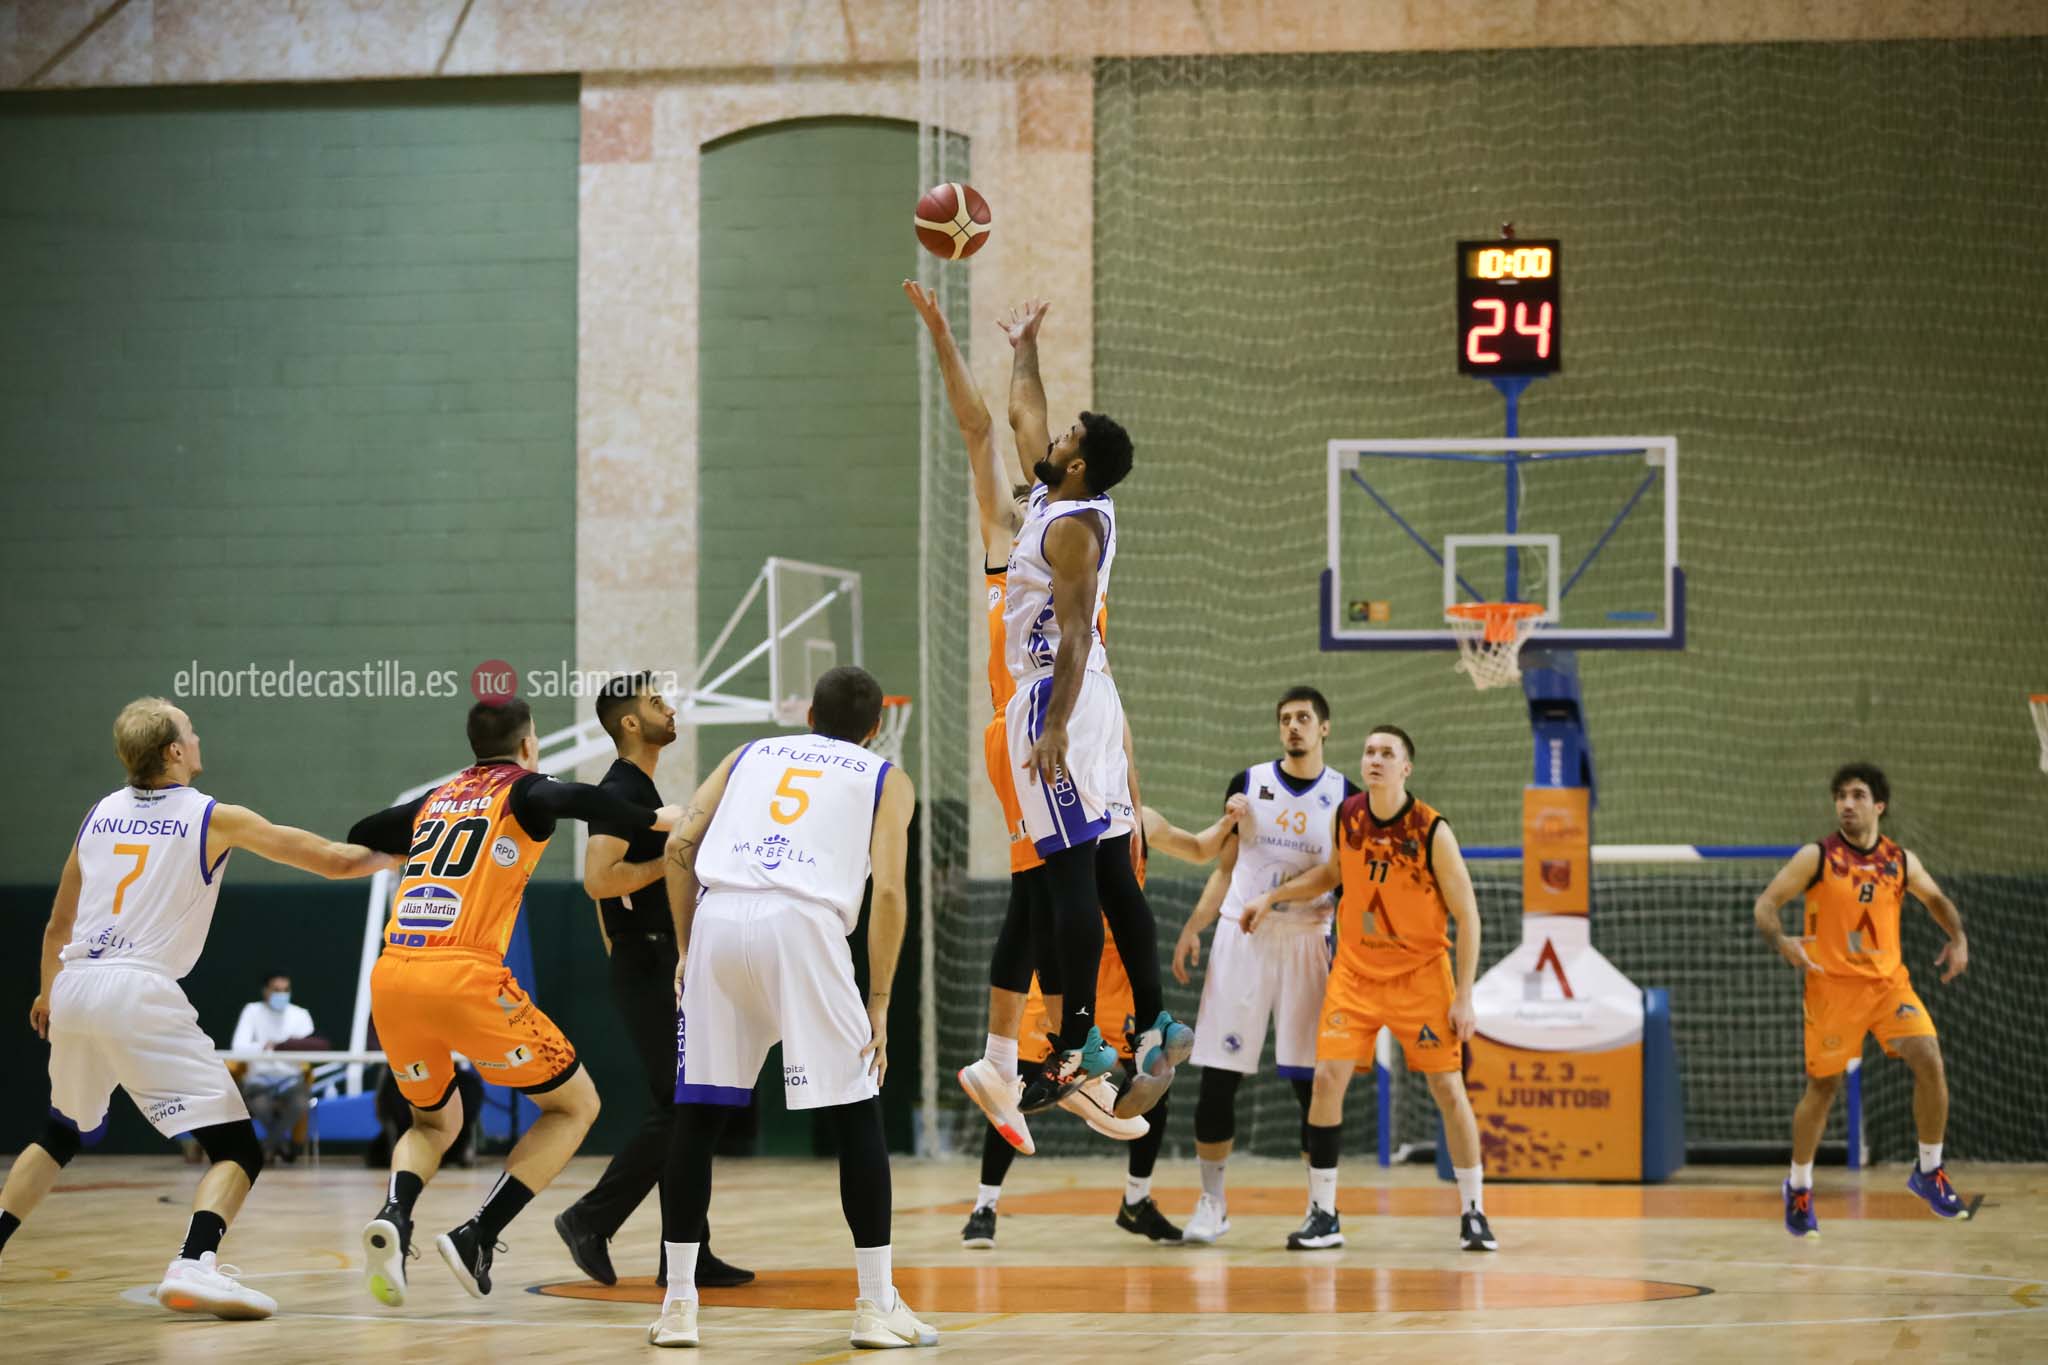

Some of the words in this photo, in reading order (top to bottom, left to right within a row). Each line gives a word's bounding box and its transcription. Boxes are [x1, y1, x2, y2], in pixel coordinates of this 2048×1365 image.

[1477, 247, 1552, 279] 10:00
[1466, 299, 1553, 363] 24
[757, 744, 868, 773] A.FUENTES
[769, 767, 824, 826] 5
[91, 817, 189, 839] KNUDSEN
[1275, 808, 1308, 835] 43
[403, 815, 492, 880] 20
[494, 842, 516, 861] RPD
[112, 842, 151, 916] 7
[1367, 859, 1391, 884] 11
